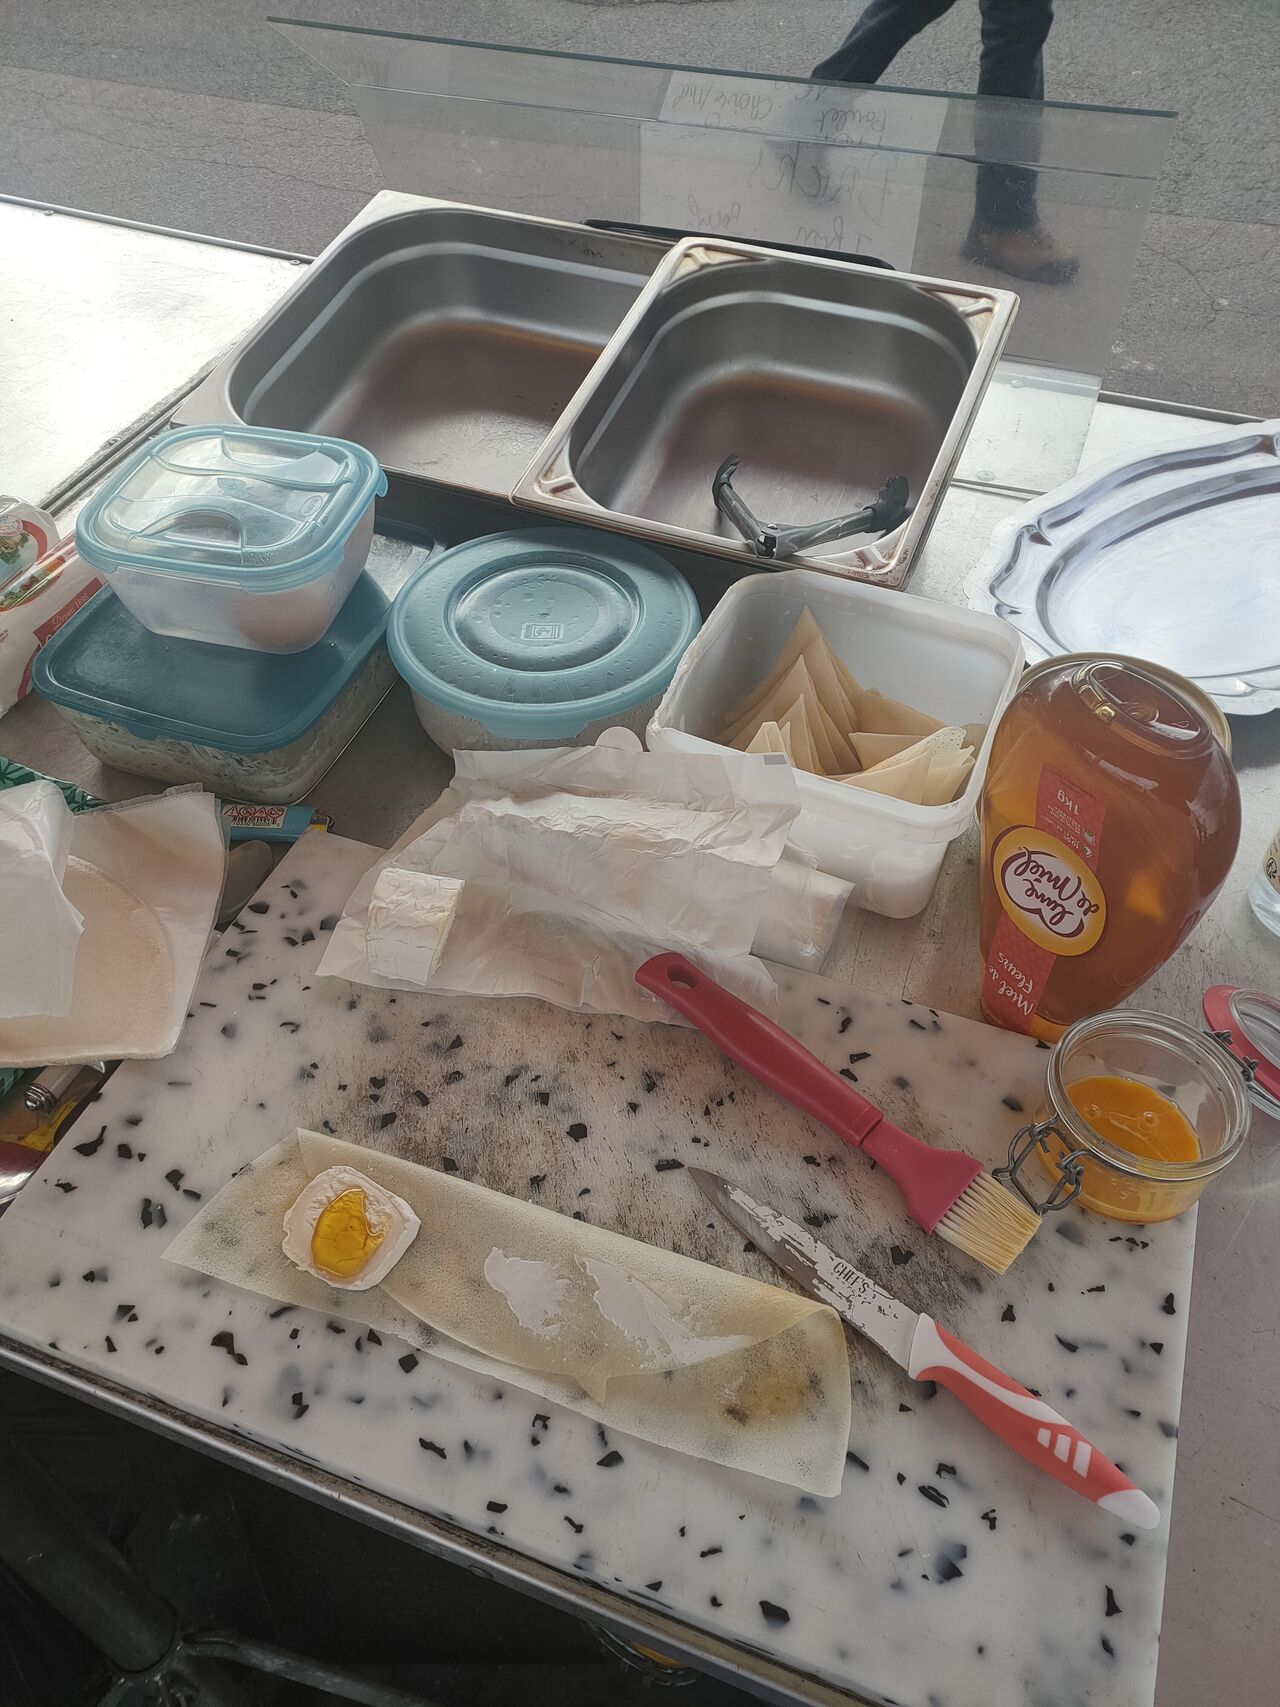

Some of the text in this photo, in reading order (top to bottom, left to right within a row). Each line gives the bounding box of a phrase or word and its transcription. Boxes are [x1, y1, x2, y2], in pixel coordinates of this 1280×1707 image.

[814, 108, 887, 133] Poulet
[1076, 890, 1100, 917] de
[998, 951, 1034, 994] Fleurs
[988, 965, 1034, 1016] Miel de
[832, 1262, 870, 1293] CHEF'S
